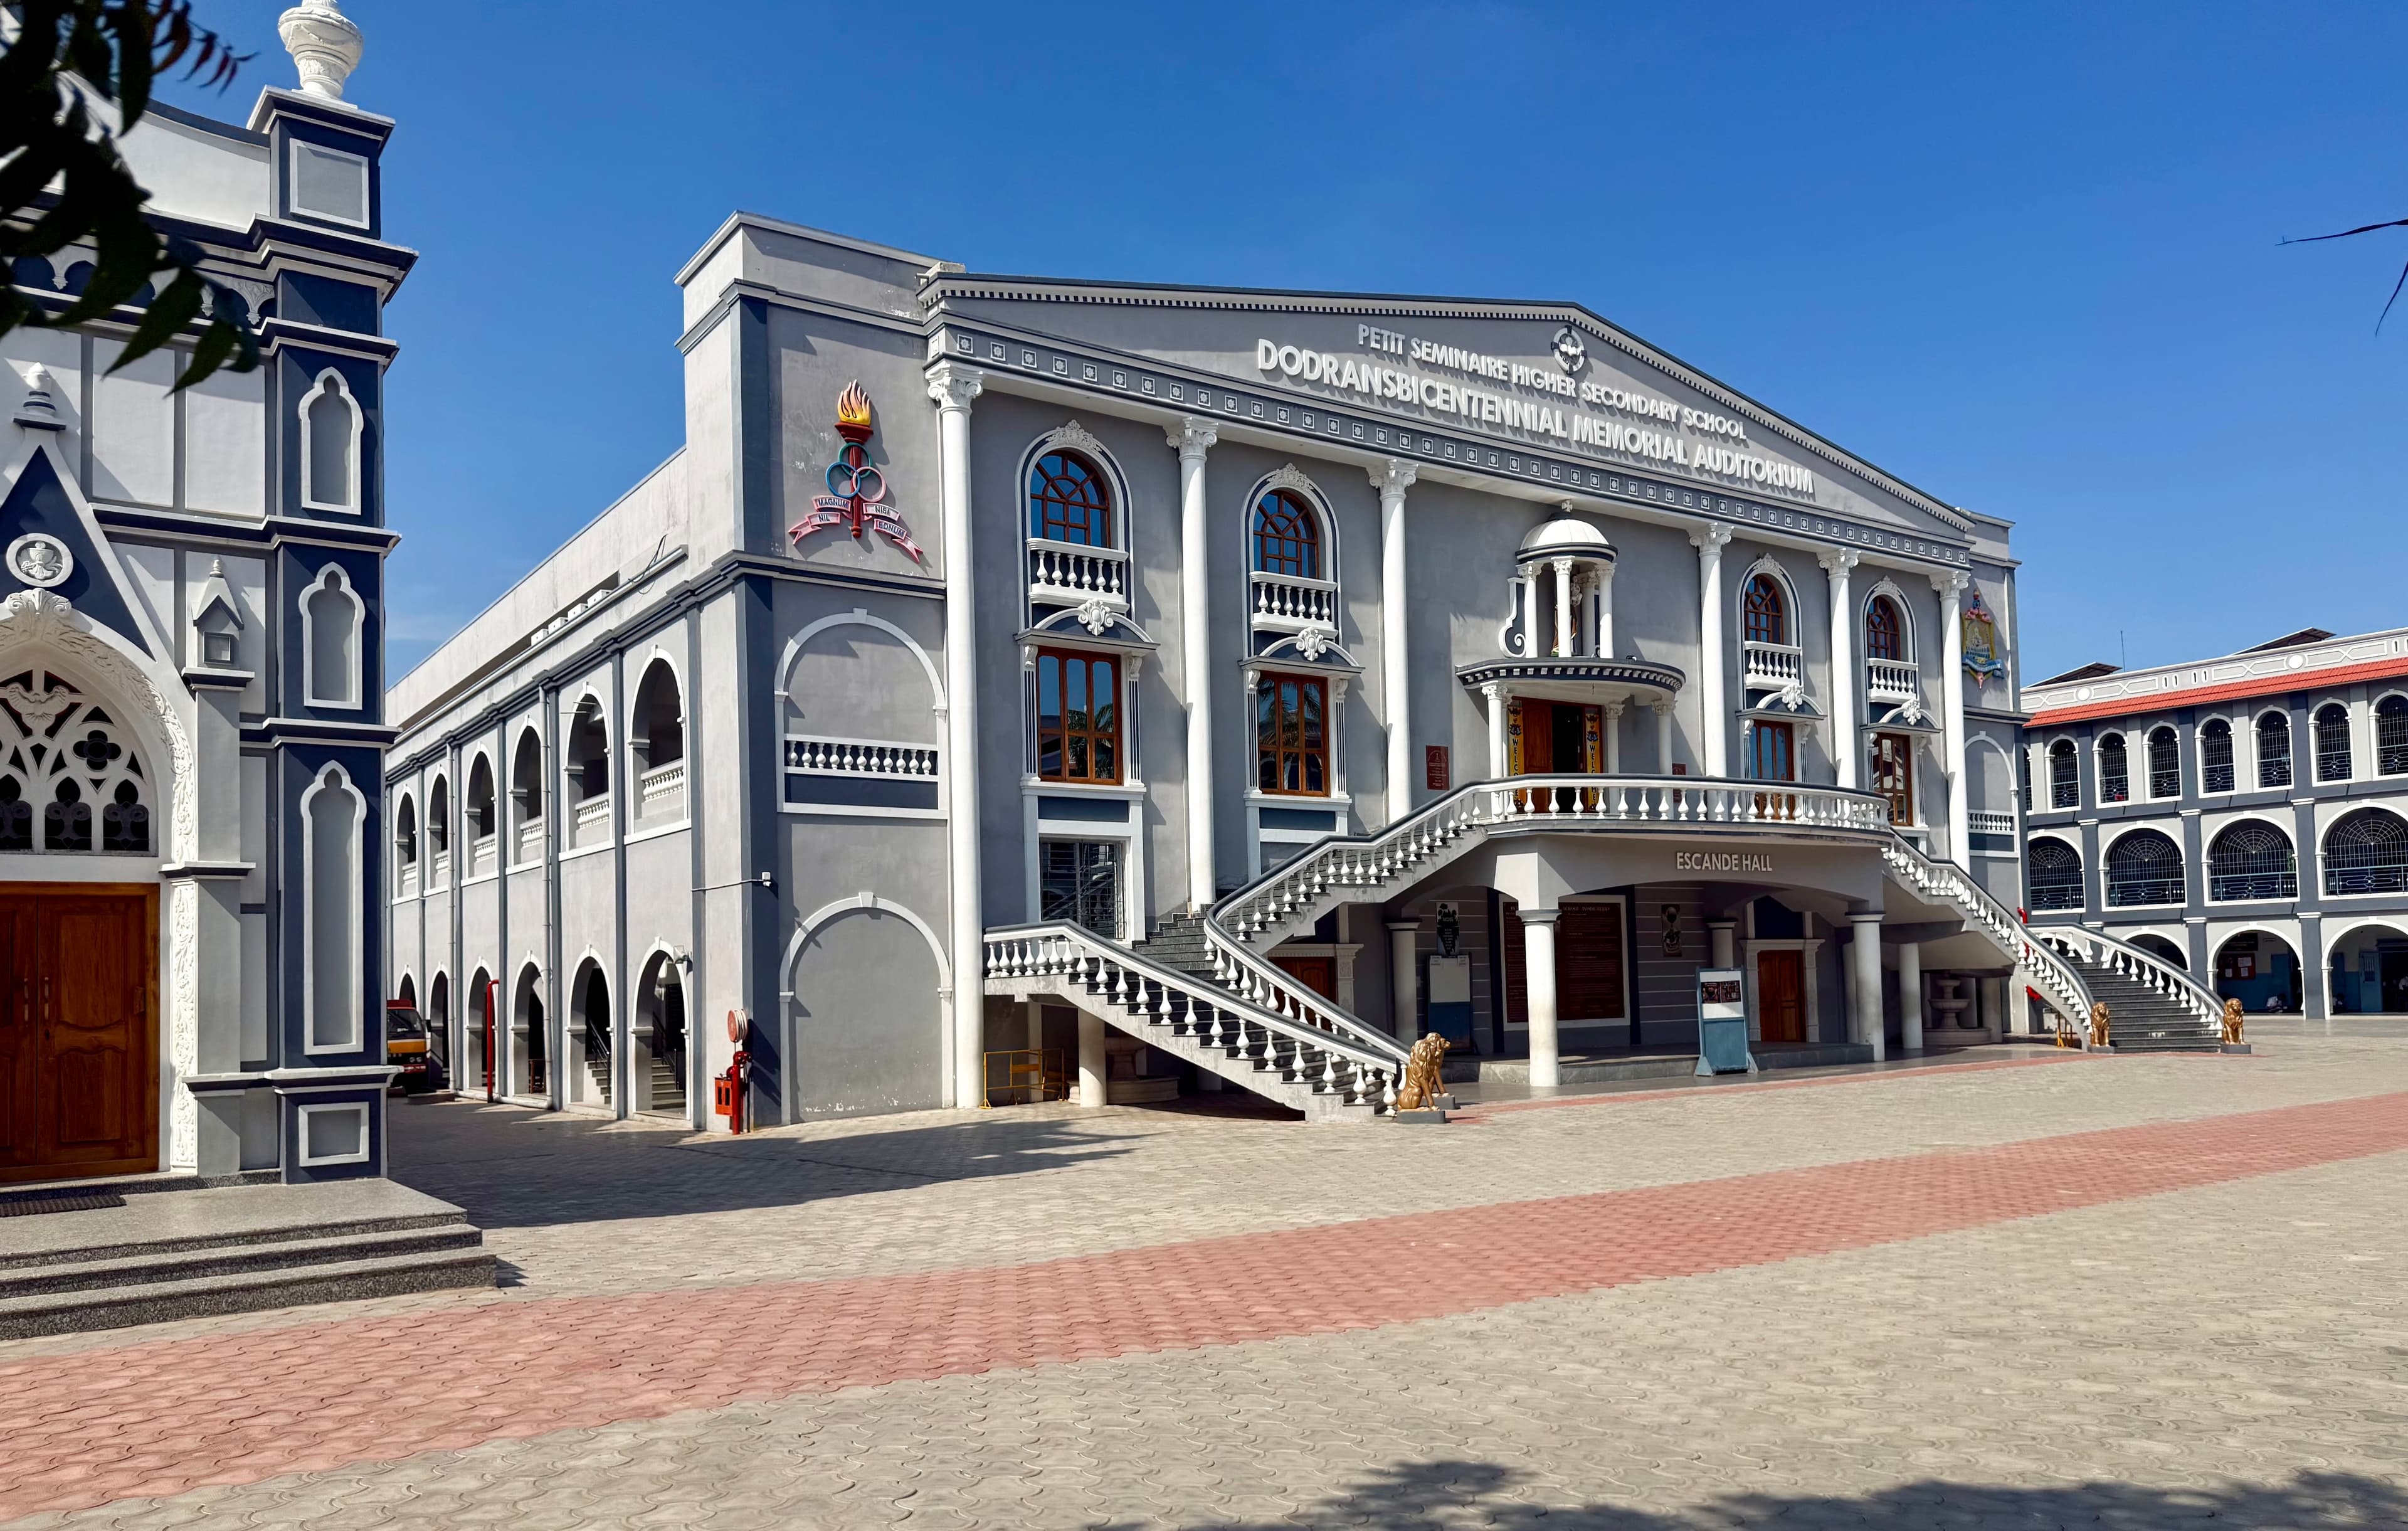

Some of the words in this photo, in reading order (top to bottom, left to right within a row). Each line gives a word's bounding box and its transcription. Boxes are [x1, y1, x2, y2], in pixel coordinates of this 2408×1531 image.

[1358, 323, 1405, 355] PETIT
[1410, 337, 1508, 381] SEMINAIRE
[1513, 363, 1576, 397] HIGHER
[1582, 381, 1679, 422] SECONDARY
[1684, 407, 1746, 439] SCHOOL
[1258, 338, 1567, 438] DODRANSBICENTENNIAL
[1573, 414, 1688, 465] MEMORIAL
[1694, 444, 1814, 493] AUDITORIUM
[818, 498, 848, 508] MAGNUM
[874, 506, 890, 514] NISI
[818, 514, 830, 522] NIL
[878, 521, 904, 536] BONUM
[1676, 852, 1739, 871] ESCANDE
[1742, 854, 1773, 872] HALL
